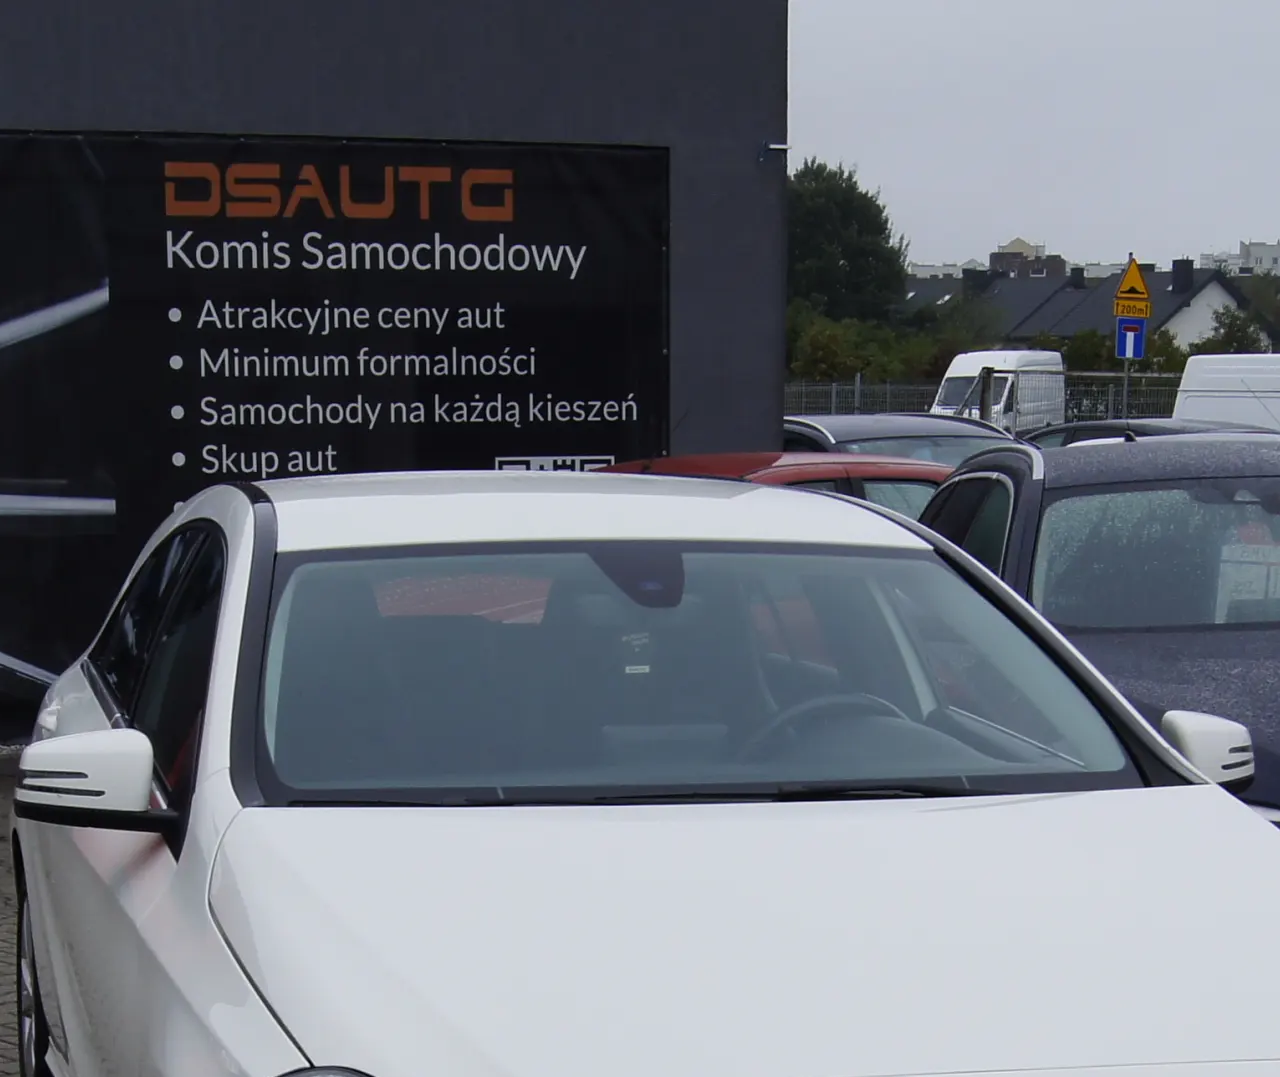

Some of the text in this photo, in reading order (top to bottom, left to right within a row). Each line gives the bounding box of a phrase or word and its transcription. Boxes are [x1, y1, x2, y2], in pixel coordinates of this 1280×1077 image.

[165, 230, 587, 280] Komis Samochodowy
[196, 299, 506, 335] Atrakcyjne ceny aut
[199, 347, 537, 377] Minimum formalności
[199, 392, 638, 430] Samochody na każdą kieszeń
[201, 443, 338, 479] Skup aut
